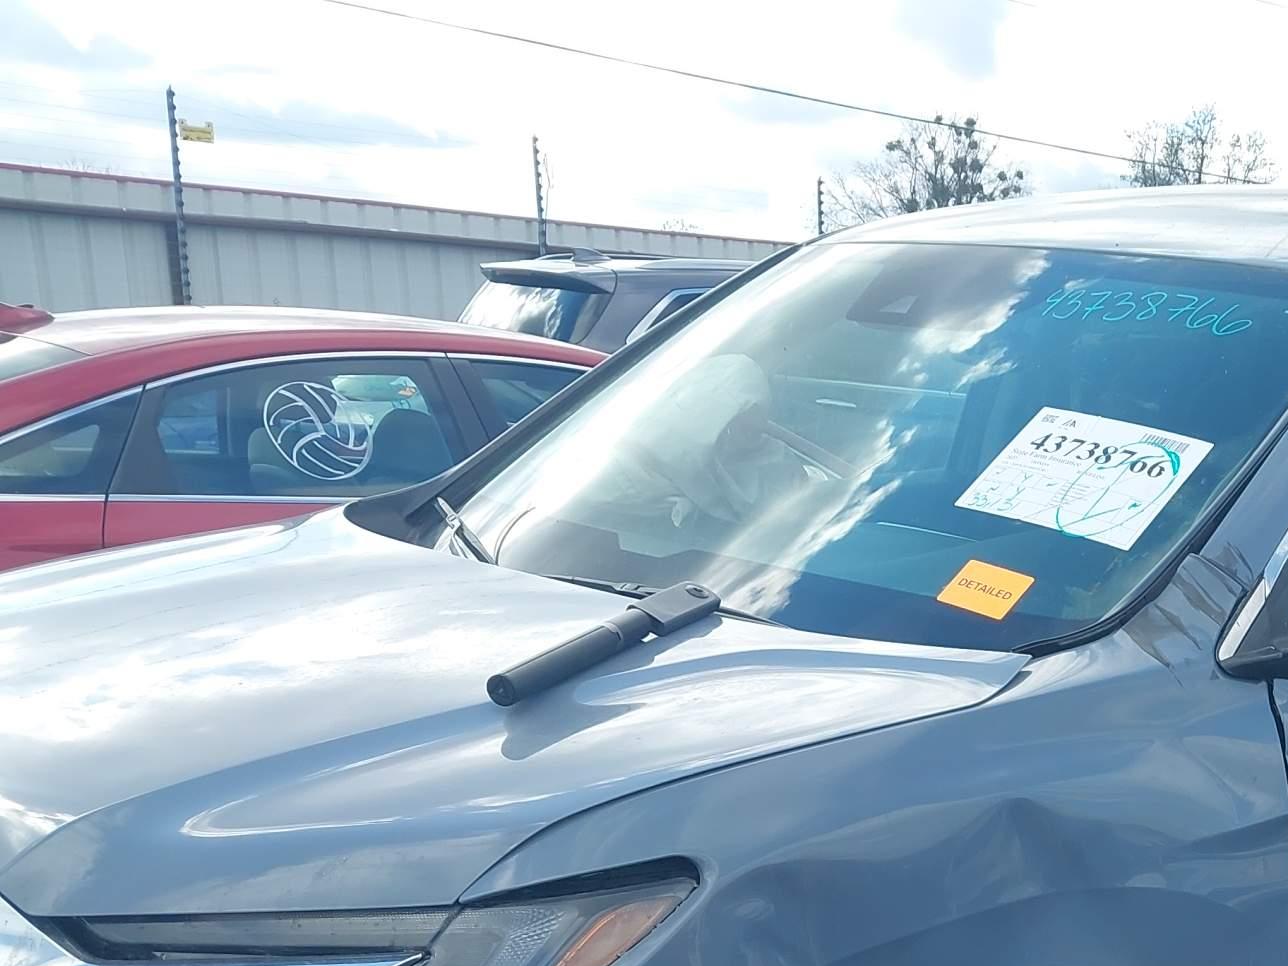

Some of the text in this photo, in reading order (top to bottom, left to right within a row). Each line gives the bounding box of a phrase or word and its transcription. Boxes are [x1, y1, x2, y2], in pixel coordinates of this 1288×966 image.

[1041, 288, 1253, 336] 43738766
[1029, 432, 1166, 479] 43738766
[957, 577, 1013, 600] DETAILED
